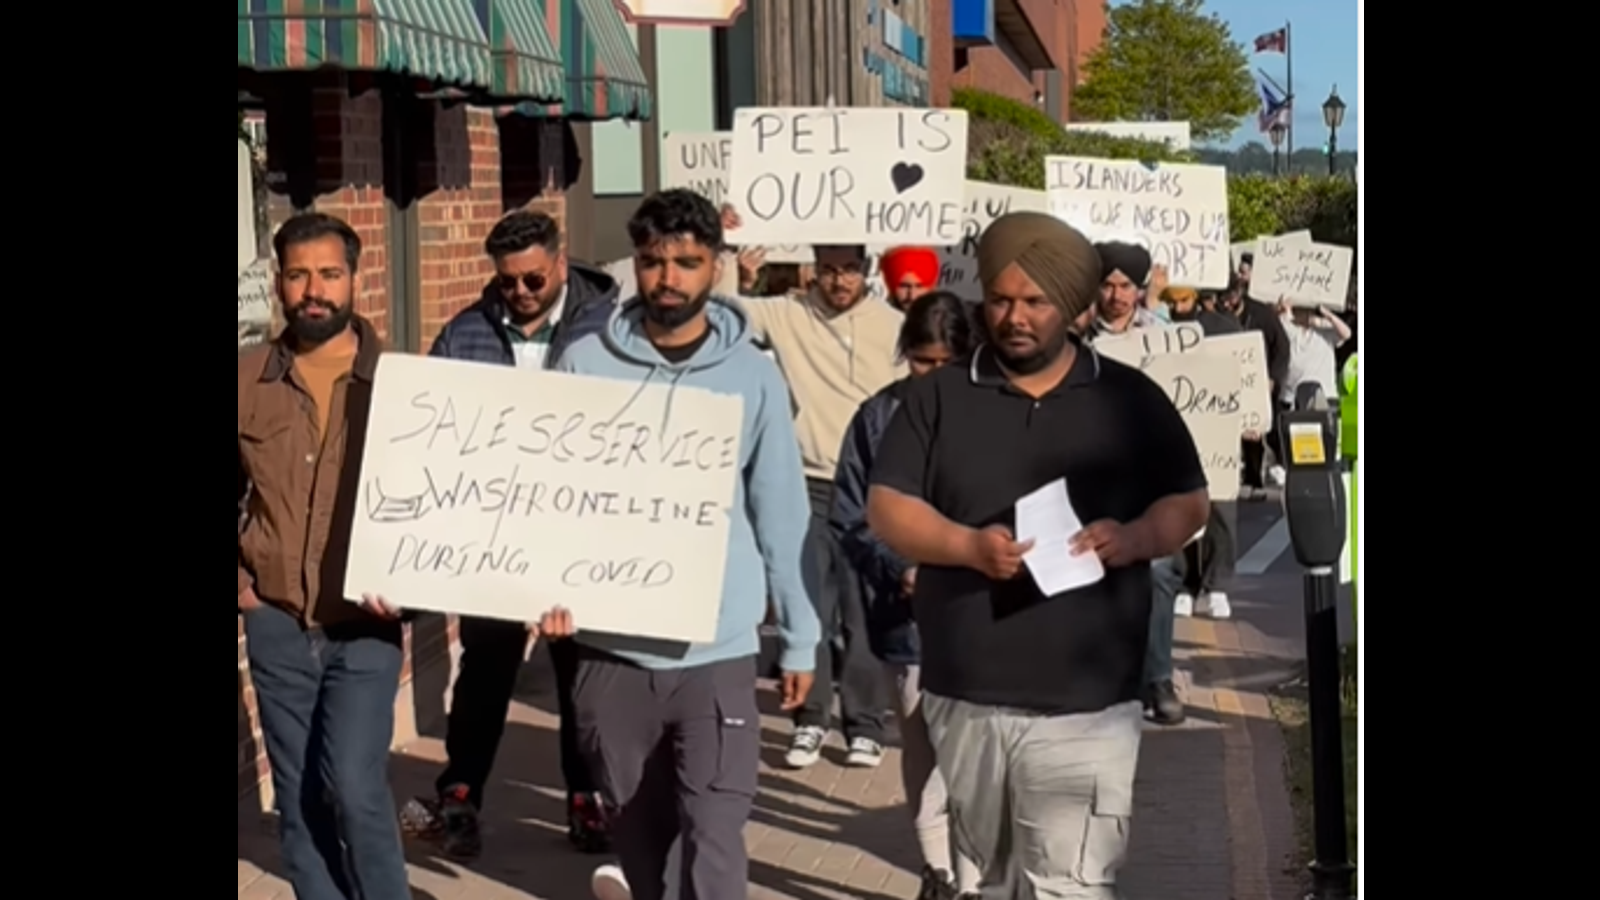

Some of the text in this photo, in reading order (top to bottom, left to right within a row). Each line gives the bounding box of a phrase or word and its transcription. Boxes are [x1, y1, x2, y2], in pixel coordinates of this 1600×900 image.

[752, 110, 952, 154] PEI IS
[681, 139, 732, 170] UNF
[746, 166, 856, 220] OUR
[1050, 162, 1183, 197] ISLANDERS
[866, 201, 958, 239] HOME
[1090, 201, 1122, 226] WE
[1133, 204, 1190, 235] NEED
[389, 532, 674, 588] DURING COVID
